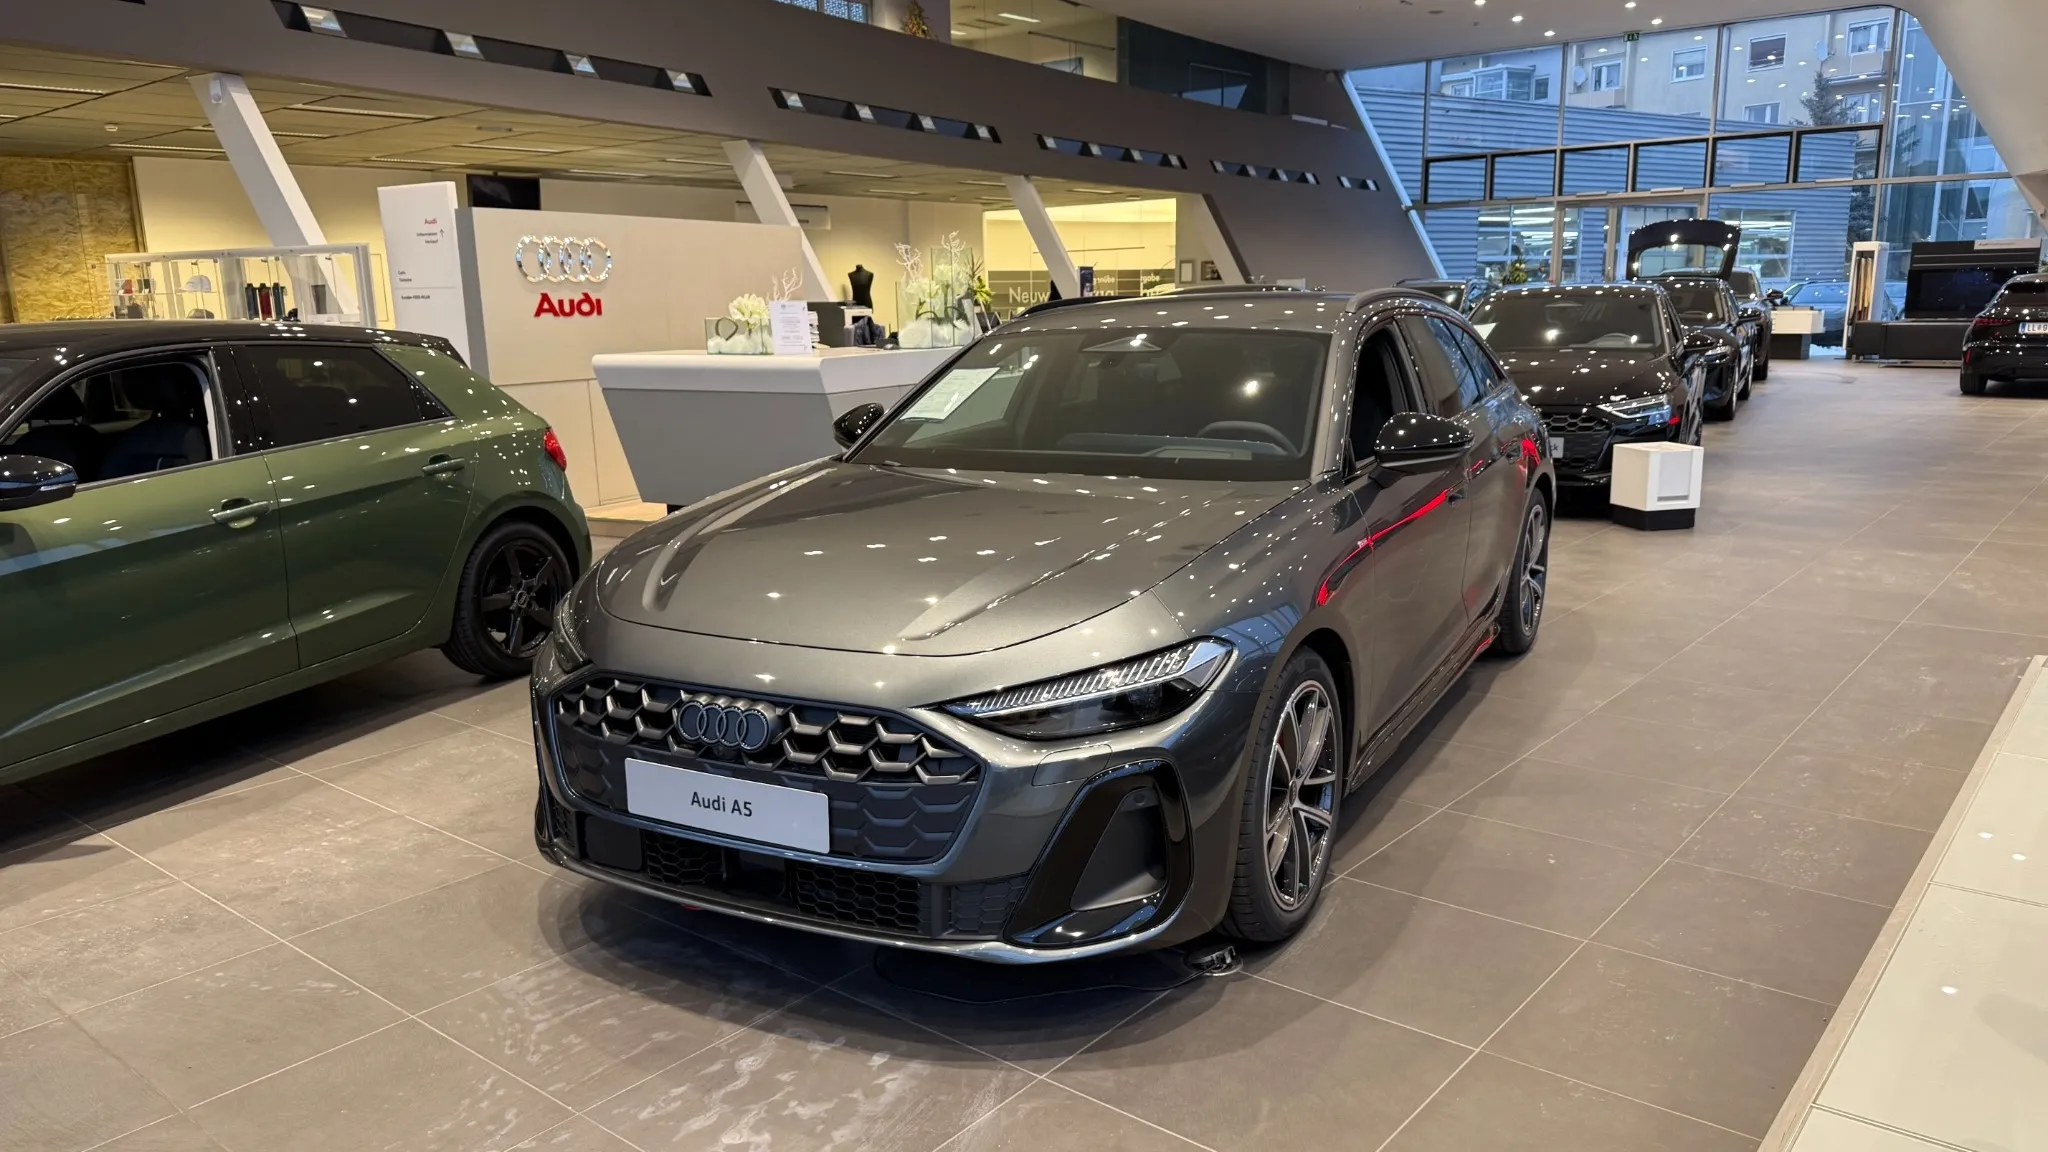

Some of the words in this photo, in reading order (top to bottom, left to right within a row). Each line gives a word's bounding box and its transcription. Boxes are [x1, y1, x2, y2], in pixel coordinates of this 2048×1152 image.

[534, 292, 603, 317] Audi
[691, 791, 726, 812] Audi
[731, 799, 753, 817] A5
